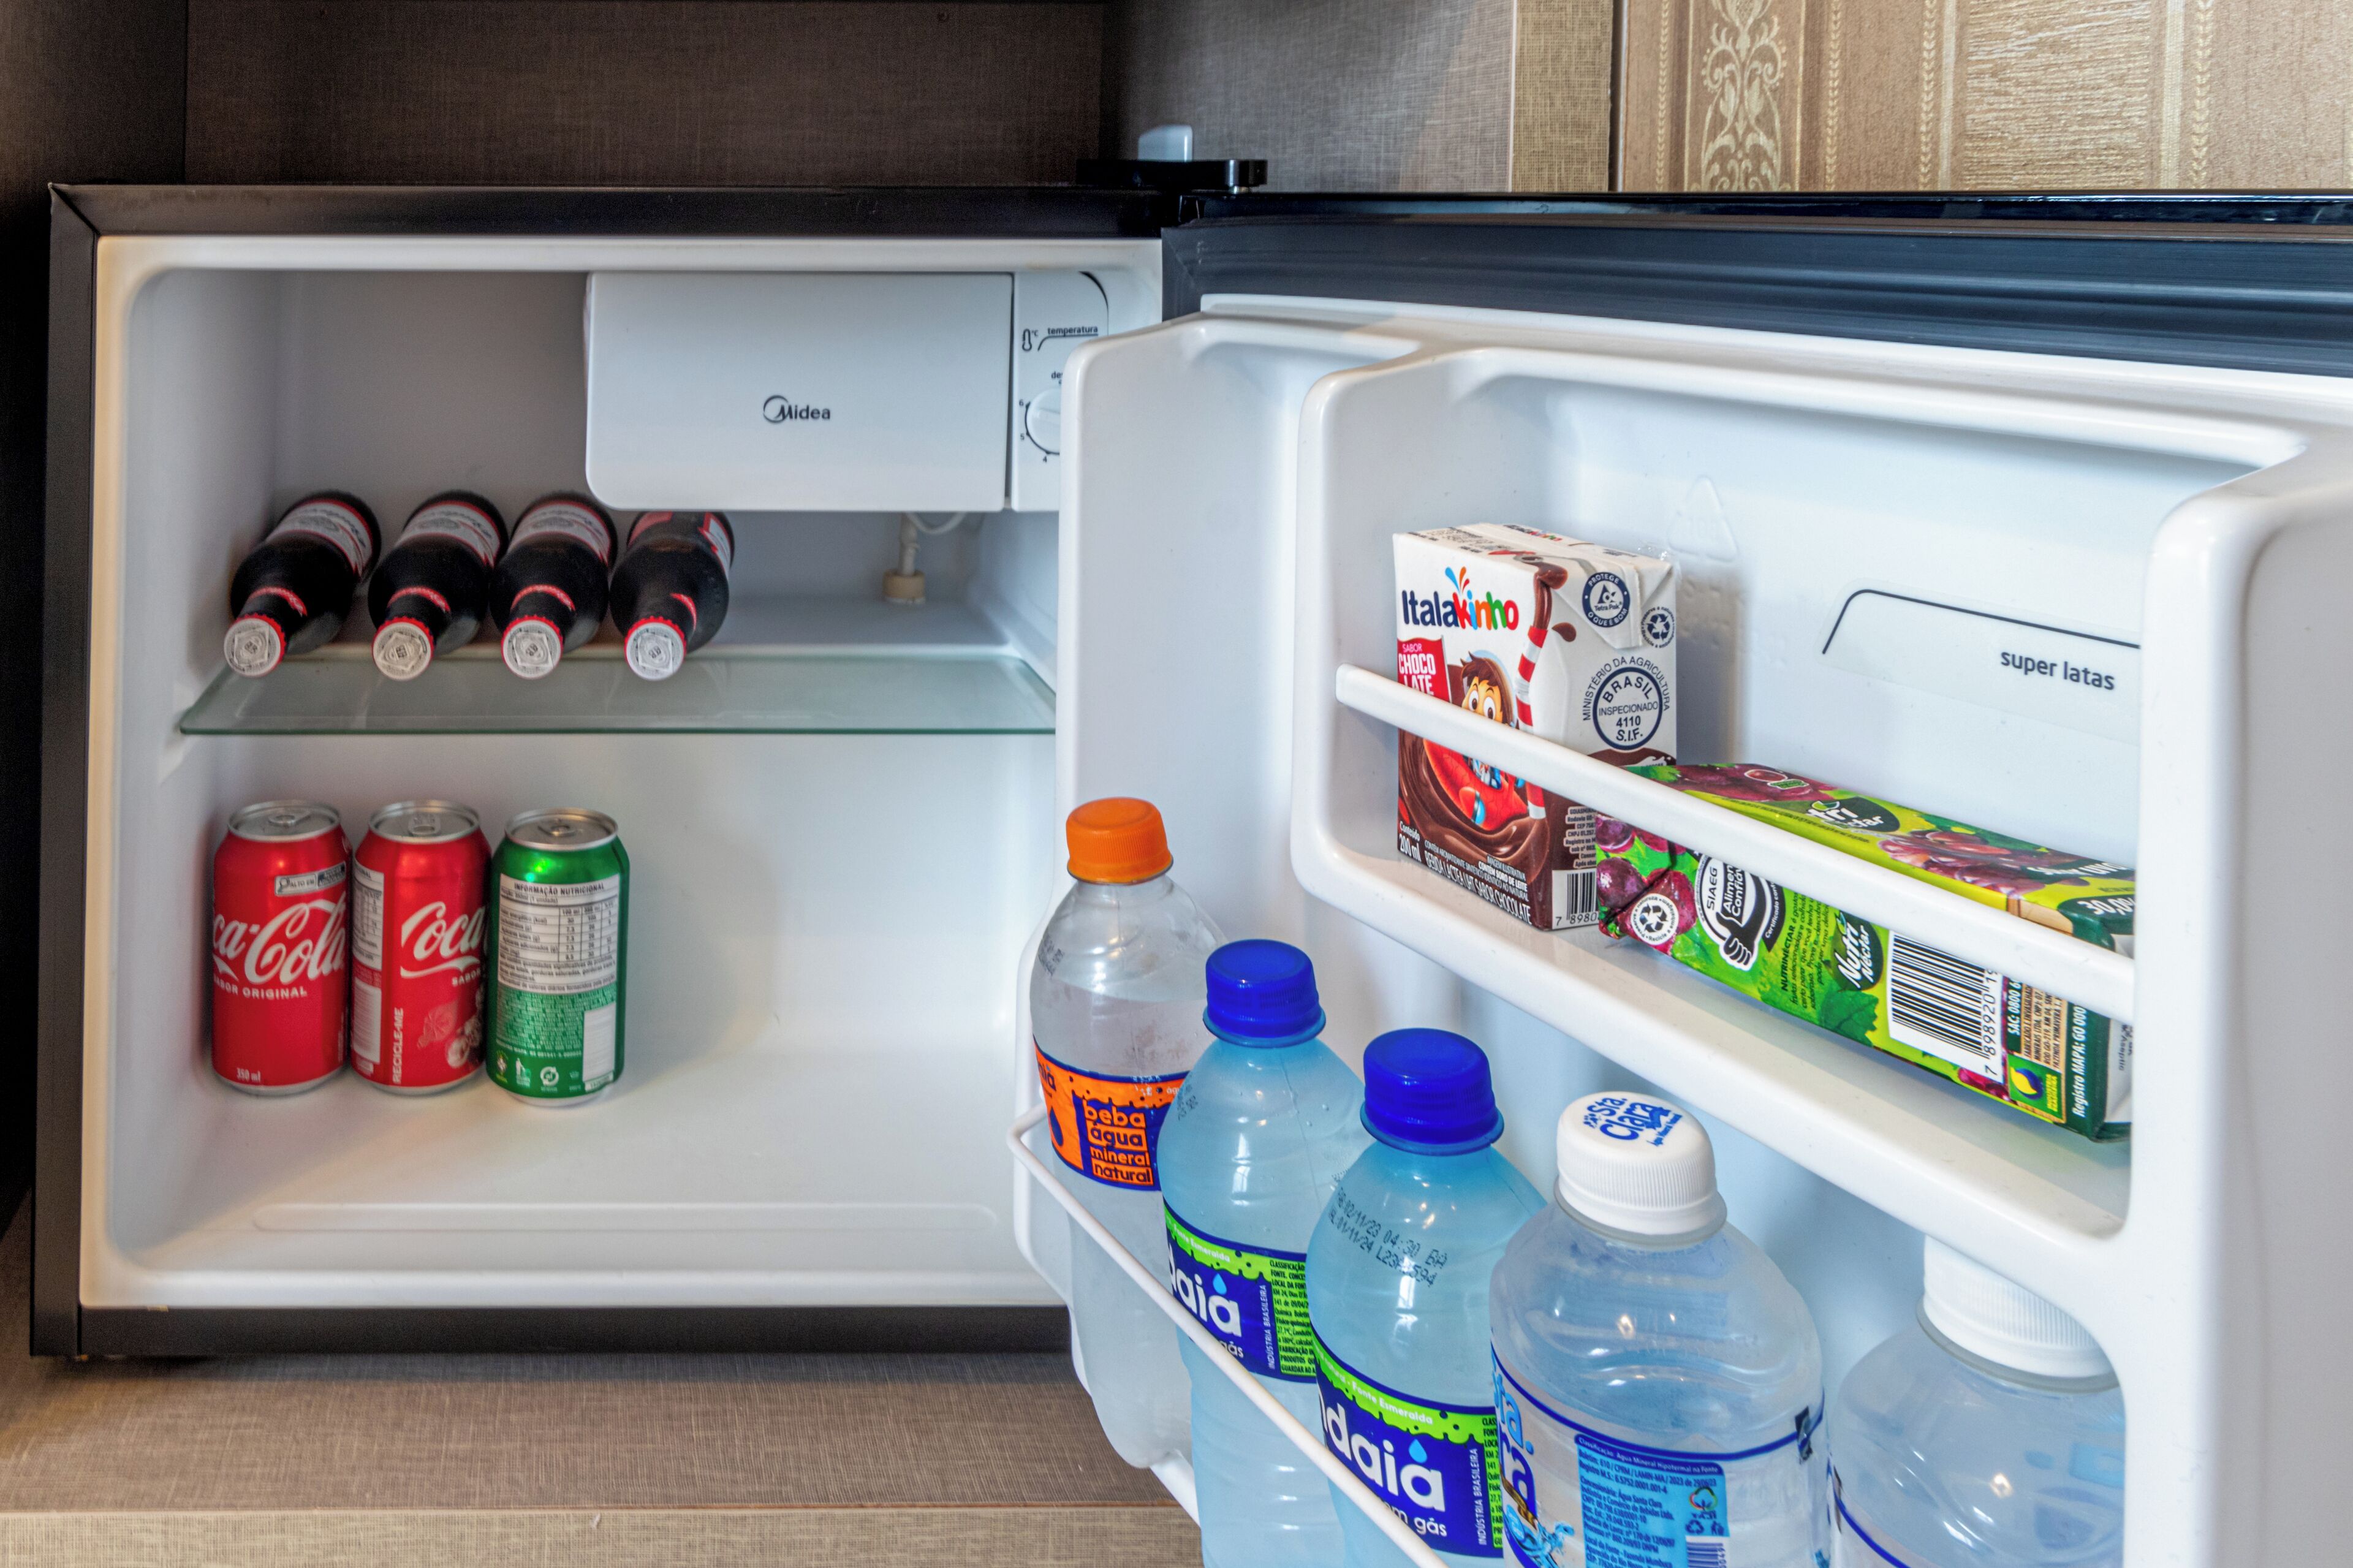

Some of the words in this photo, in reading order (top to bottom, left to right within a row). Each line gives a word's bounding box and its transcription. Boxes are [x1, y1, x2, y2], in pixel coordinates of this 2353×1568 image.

[1047, 326, 1099, 336] temperatura
[771, 403, 831, 420] Midea
[1588, 574, 1620, 586] PROTEGE
[1401, 590, 1519, 631] Italakinho
[1593, 617, 1608, 626] QUE
[1615, 608, 1627, 623] BOM
[1403, 643, 1422, 653] SABOR
[1398, 653, 1436, 675] CHOCO
[2001, 651, 2058, 675] super
[2063, 661, 2115, 691] latas
[1404, 674, 1434, 696] LATE
[1582, 664, 1612, 721] MINISTÉRIO
[1613, 657, 1627, 667] DA
[1629, 656, 1670, 711] AGRICULTURA
[1602, 676, 1653, 703] BRASIL
[1599, 701, 1659, 716] INSPECIONADO
[1616, 715, 1641, 728] 4110
[1616, 728, 1643, 742] S.I.F.
[1400, 821, 1420, 841] Conteúdo
[1400, 833, 1412, 857] 200
[1412, 842, 1422, 863] ml
[1478, 861, 1496, 877] CONTÉM
[1496, 869, 1508, 882] SORO
[1509, 874, 1515, 886] DE
[1515, 878, 1528, 892] LEITE
[514, 883, 558, 896] INFORMAÇÃO
[560, 882, 604, 895] NUTRICIONAL
[1509, 884, 1529, 903] NATURAL
[1707, 866, 1718, 911] SIAEG
[1476, 879, 1495, 906] SABOR
[1495, 889, 1532, 925] CHOCOLATE
[1555, 916, 1562, 926] 7
[1570, 912, 1597, 925] 8980
[1765, 901, 1780, 939] Certificado
[1835, 922, 1862, 988] Nutri
[452, 967, 481, 988] SABOR
[243, 985, 308, 1001] ORIGINAL
[2007, 989, 2021, 1014] 0800
[2007, 1015, 2020, 1037] SAC:
[2053, 1010, 2061, 1043] PRIMAVERA
[2071, 1026, 2087, 1042] GO
[393, 1007, 404, 1085] RECICLE-ME
[2023, 1027, 2033, 1058] FABRICADO
[2053, 1045, 2061, 1069] FAZENDA
[2071, 1042, 2086, 1076] MAPA:
[237, 1067, 250, 1082] 350
[251, 1070, 262, 1083] ml
[1586, 1097, 1628, 1117] Sta.
[2071, 1074, 2090, 1118] Registro
[1083, 1099, 1146, 1128] beba
[1599, 1102, 1672, 1141] Clara
[1090, 1122, 1143, 1148] água
[1090, 1146, 1151, 1167] mineral
[1095, 1162, 1151, 1183] natural
[1190, 1238, 1230, 1263] Esmeralda
[1271, 1279, 1286, 1288] LOCAL
[1259, 1285, 1271, 1328] BRASILEIRA
[1264, 1330, 1276, 1370] INDÚSTRIA
[1351, 1381, 1377, 1404] Fonte
[1379, 1397, 1434, 1425] Esmeralda
[1469, 1448, 1484, 1498] BRASILEIRA
[1487, 1461, 1496, 1469] 141
[1633, 1458, 1656, 1468] Mineral
[1657, 1461, 1691, 1472] Hipotermal
[1607, 1494, 1631, 1510] Comércio
[1632, 1495, 1648, 1506] Santa
[1648, 1499, 1662, 1509] Clara
[1414, 1516, 1447, 1537] gás
[1472, 1501, 1488, 1546] INDÚSTRIA
